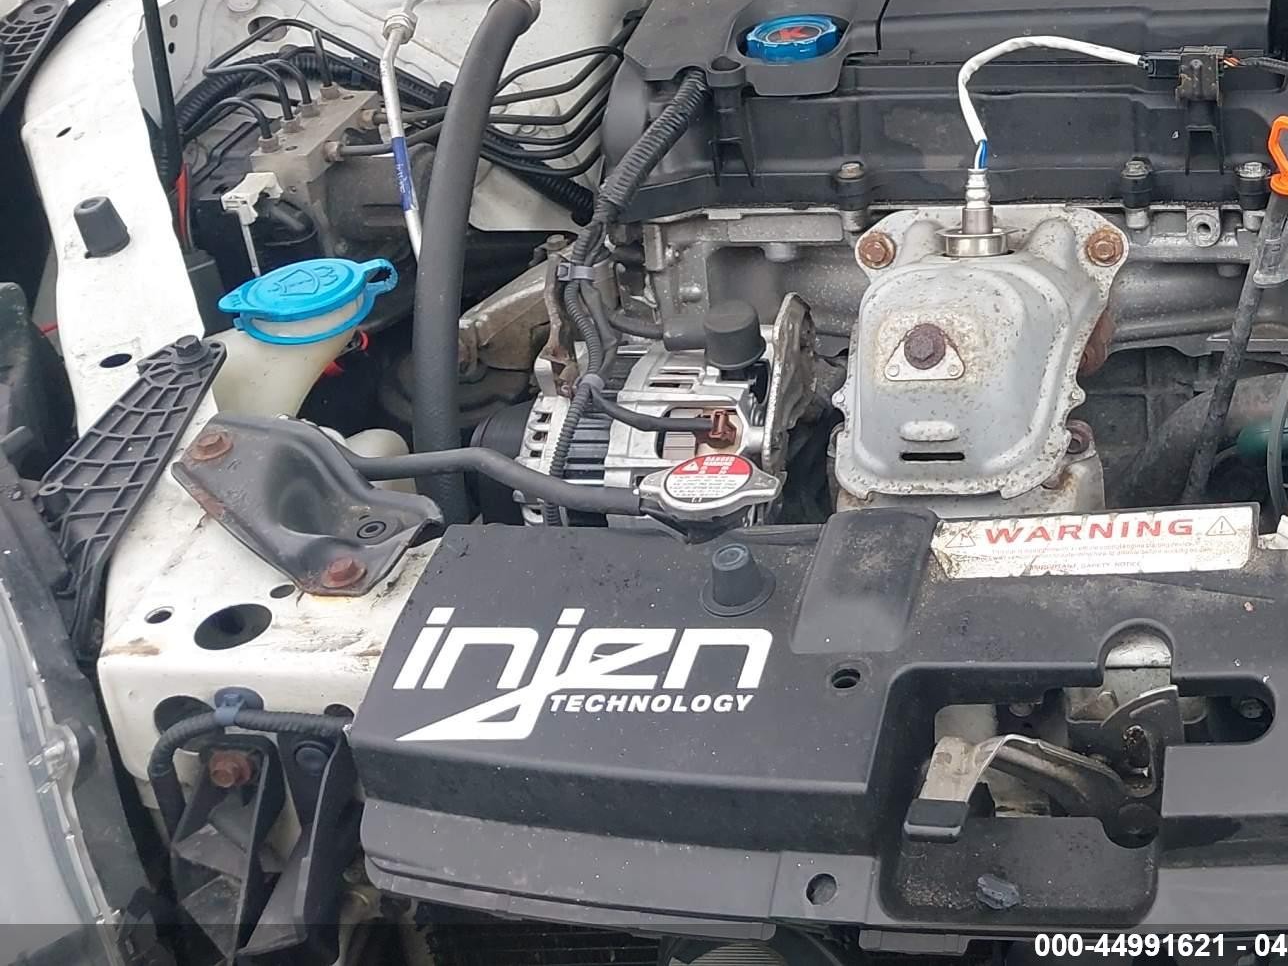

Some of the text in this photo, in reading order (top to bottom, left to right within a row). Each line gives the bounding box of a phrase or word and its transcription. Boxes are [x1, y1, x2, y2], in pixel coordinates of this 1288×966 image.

[985, 518, 1194, 545] WARNING
[392, 606, 774, 743] injen
[549, 693, 755, 713] TECHNOLOGY
